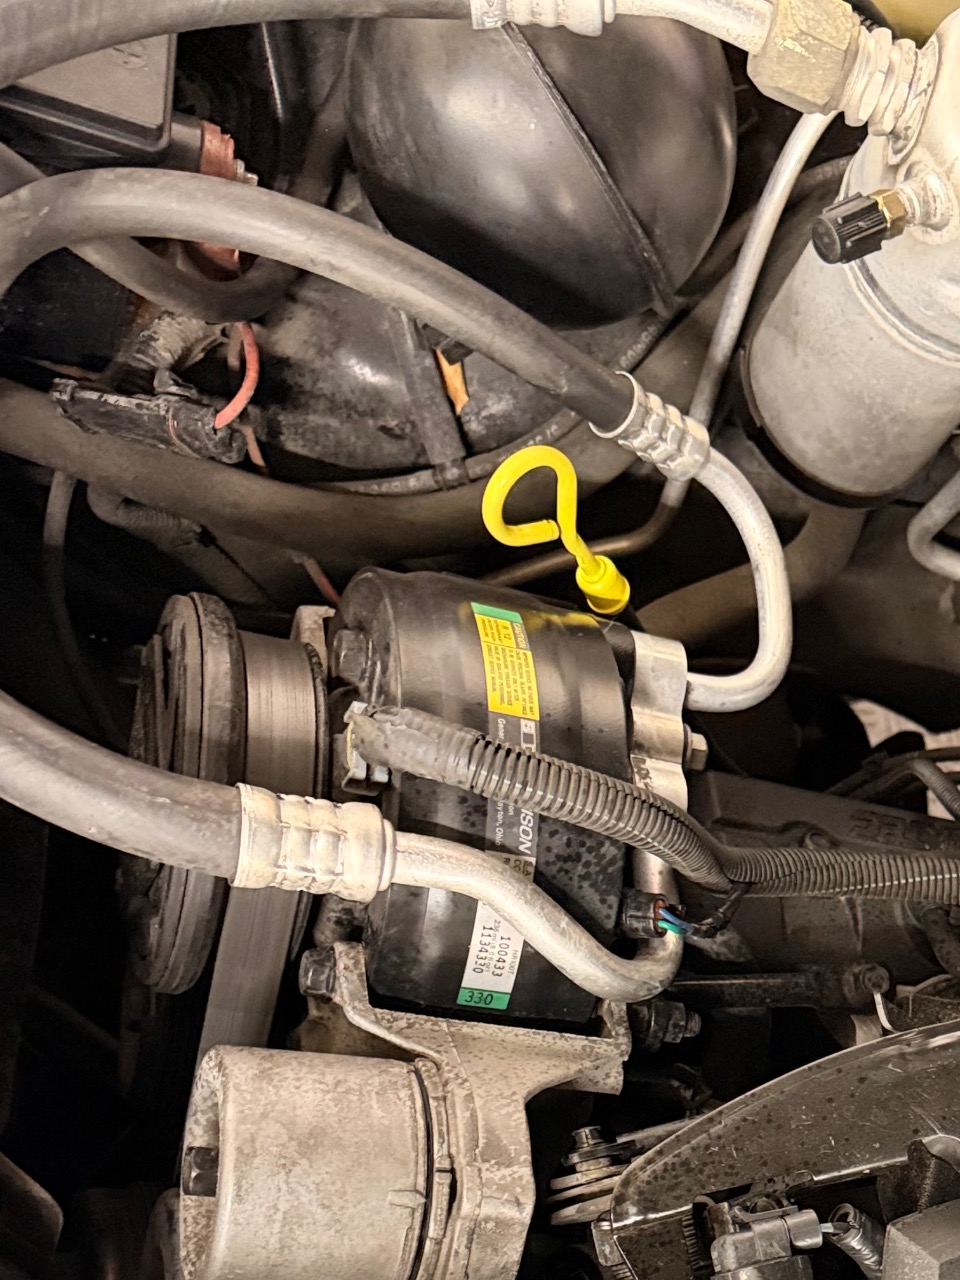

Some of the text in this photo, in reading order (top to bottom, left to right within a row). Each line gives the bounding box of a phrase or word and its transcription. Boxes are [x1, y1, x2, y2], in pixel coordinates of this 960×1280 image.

[513, 623, 526, 648] CAUTION
[498, 718, 506, 739] Gener
[495, 800, 504, 826] ayton,
[518, 808, 534, 854] ISON
[472, 926, 494, 974] 1134330
[492, 936, 512, 977] 100433
[464, 991, 494, 1006] 330
